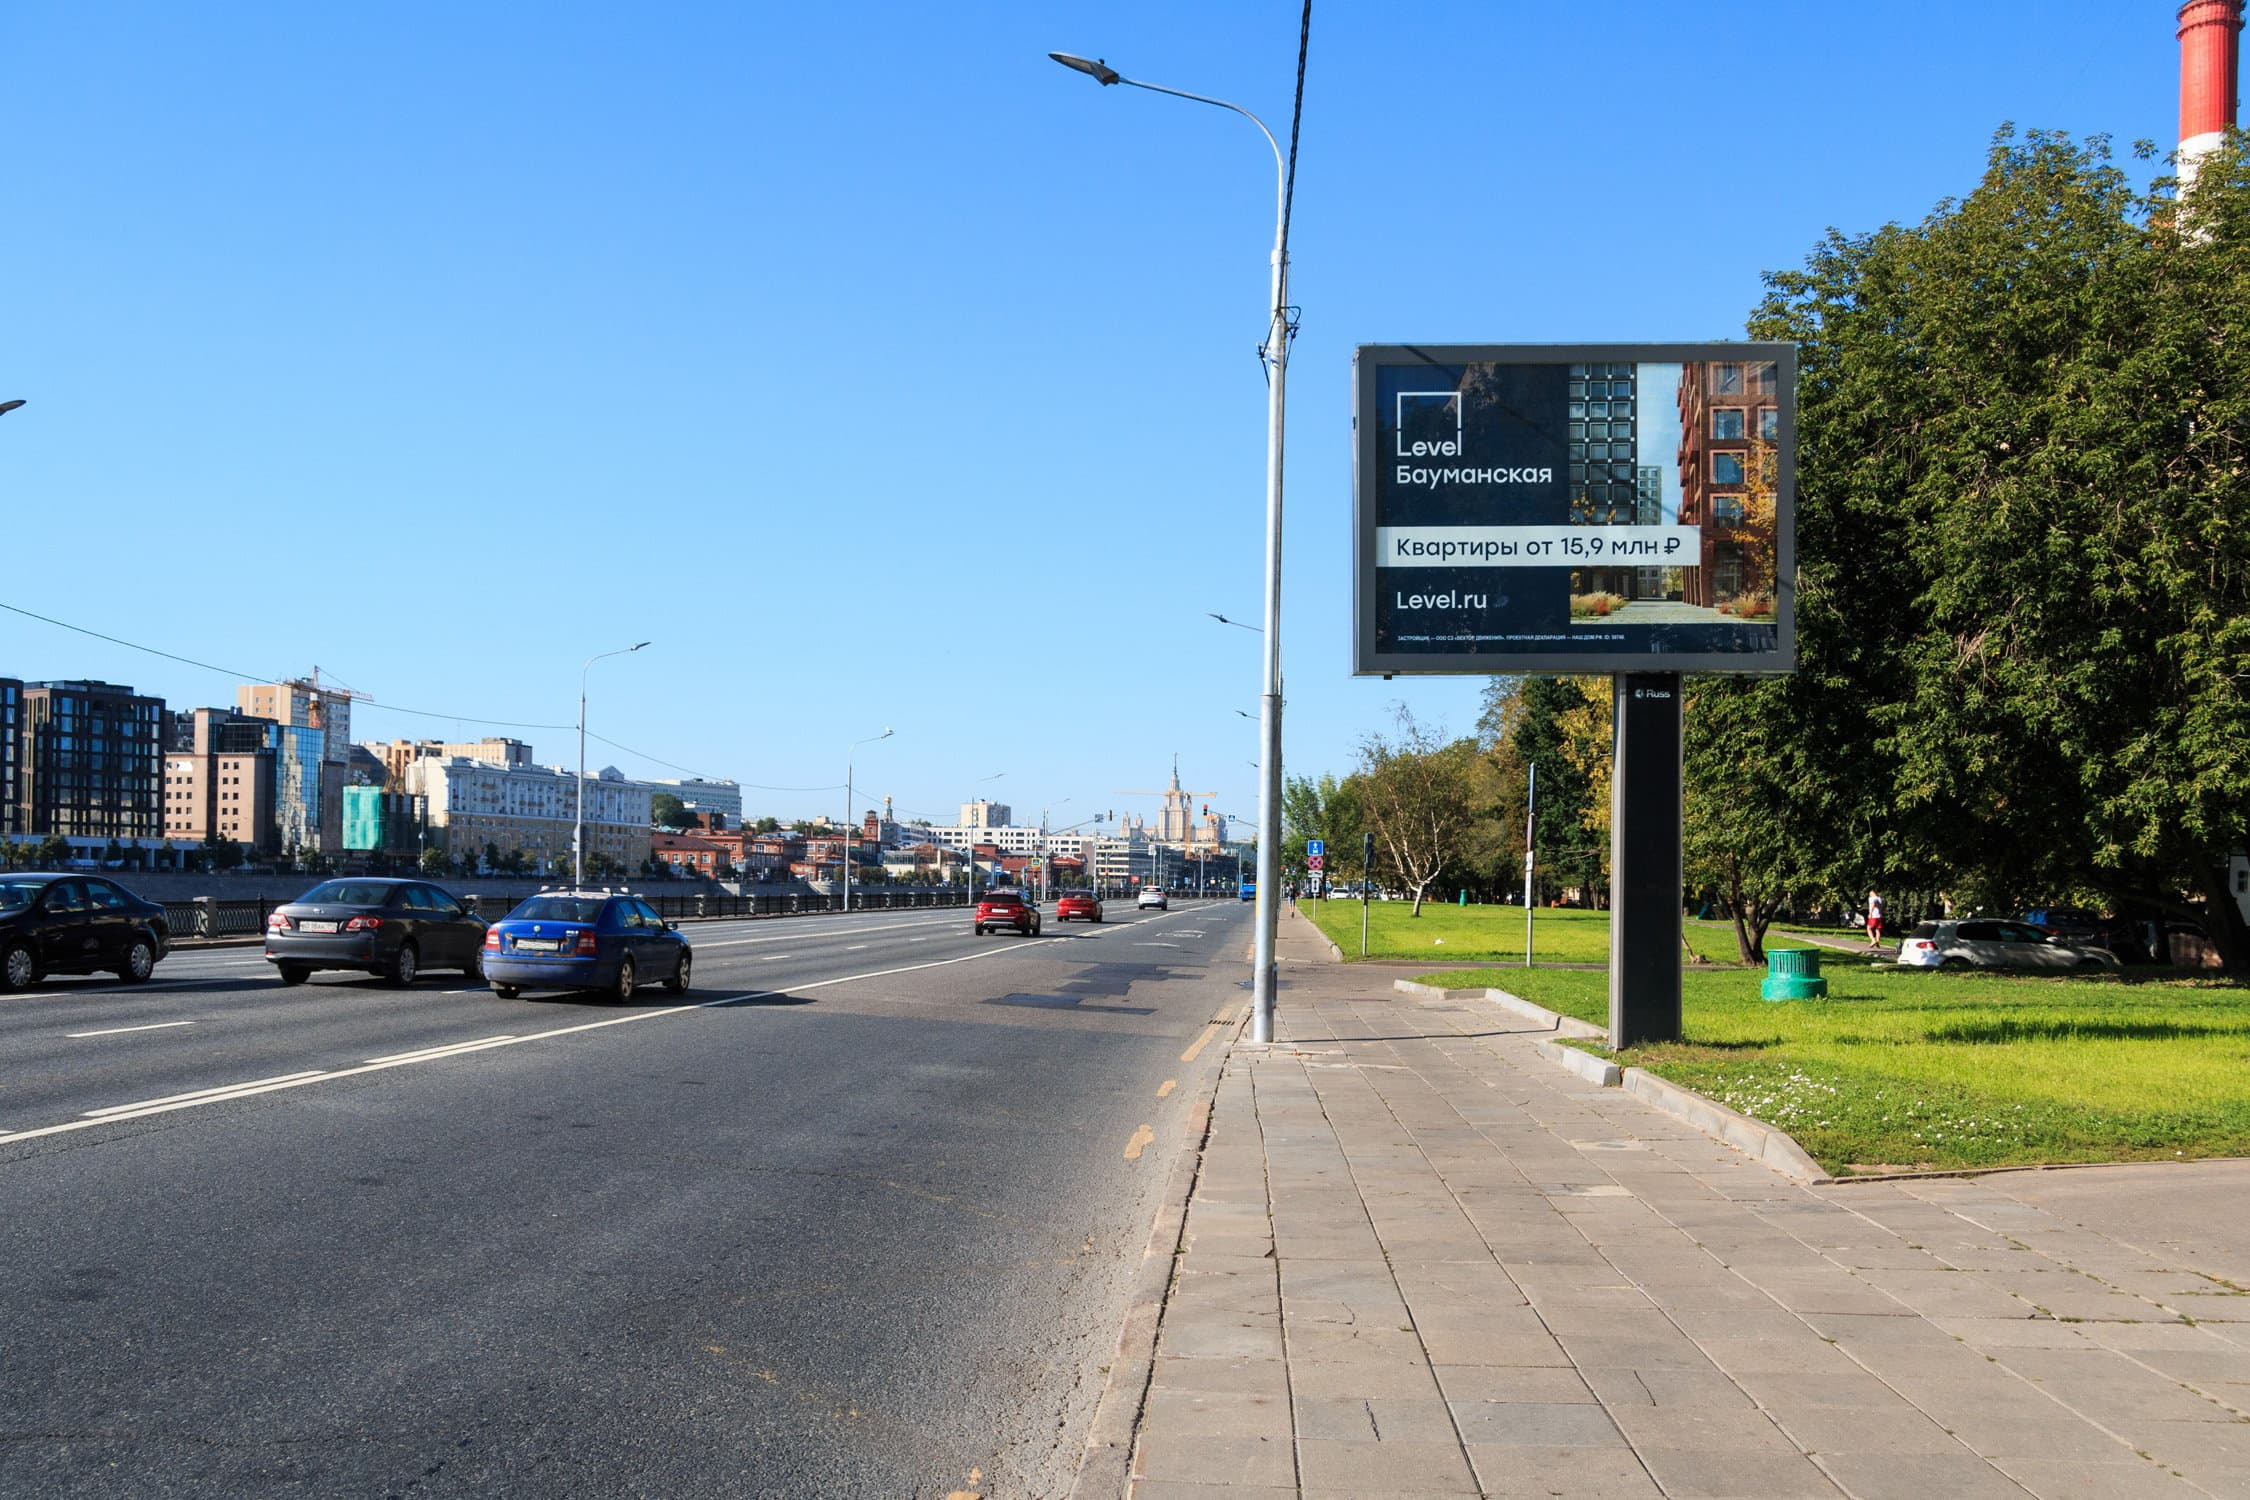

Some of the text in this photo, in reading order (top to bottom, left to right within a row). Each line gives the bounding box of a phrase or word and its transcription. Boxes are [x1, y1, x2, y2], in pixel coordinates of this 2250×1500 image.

[1396, 430, 1462, 457] Level
[1396, 465, 1553, 490] Бауманская
[1397, 538, 1518, 561] Квартиры
[1526, 540, 1554, 556] от
[1560, 537, 1604, 558] 15,9
[1611, 540, 1659, 556] млн
[1396, 590, 1487, 609] Level.ru
[1646, 689, 1671, 698] Russ
